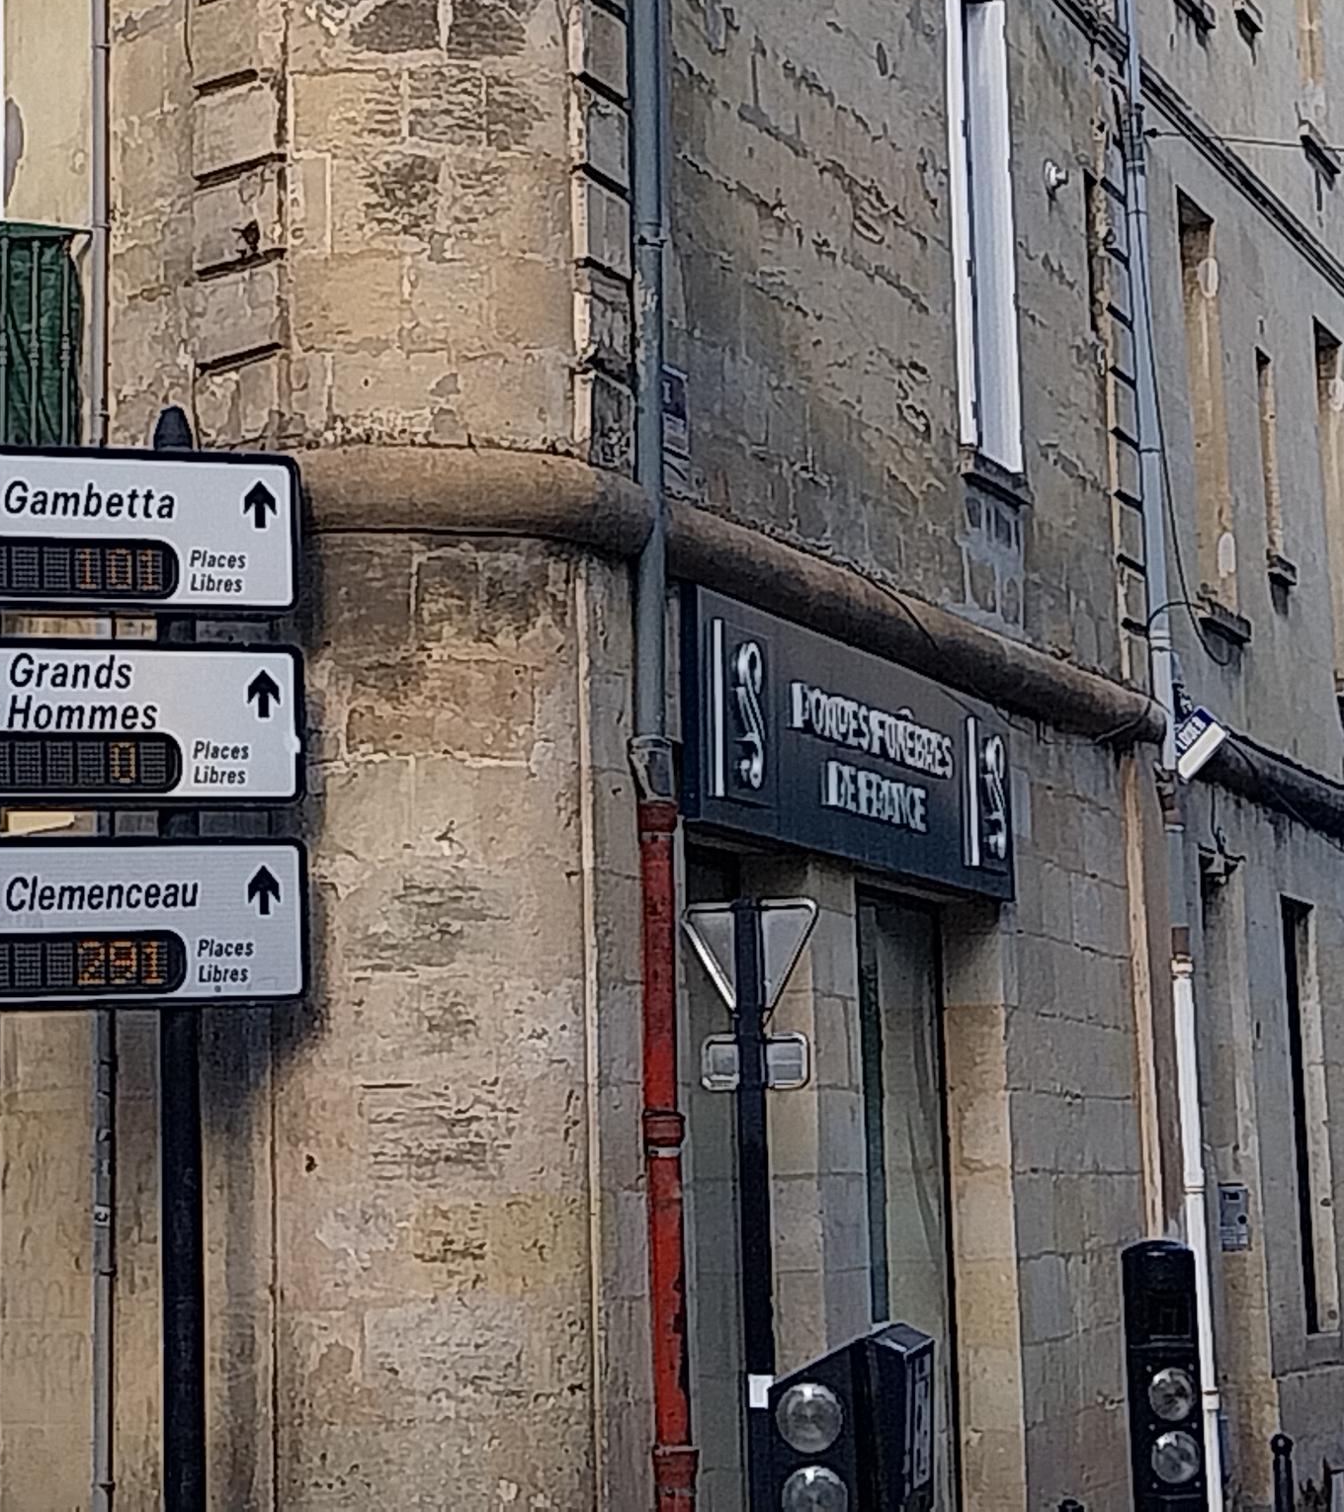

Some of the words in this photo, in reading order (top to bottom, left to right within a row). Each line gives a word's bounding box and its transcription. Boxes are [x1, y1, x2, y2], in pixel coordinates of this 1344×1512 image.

[4, 480, 176, 520] Gambetta
[189, 549, 247, 570] Places
[189, 573, 244, 594] Libres
[8, 654, 134, 689] Grands
[6, 697, 158, 732] Hommes
[193, 741, 250, 762] Places
[193, 765, 247, 786] Libres
[6, 875, 200, 912] Clemenceau
[197, 939, 255, 960] Places
[198, 963, 250, 984] Libres
